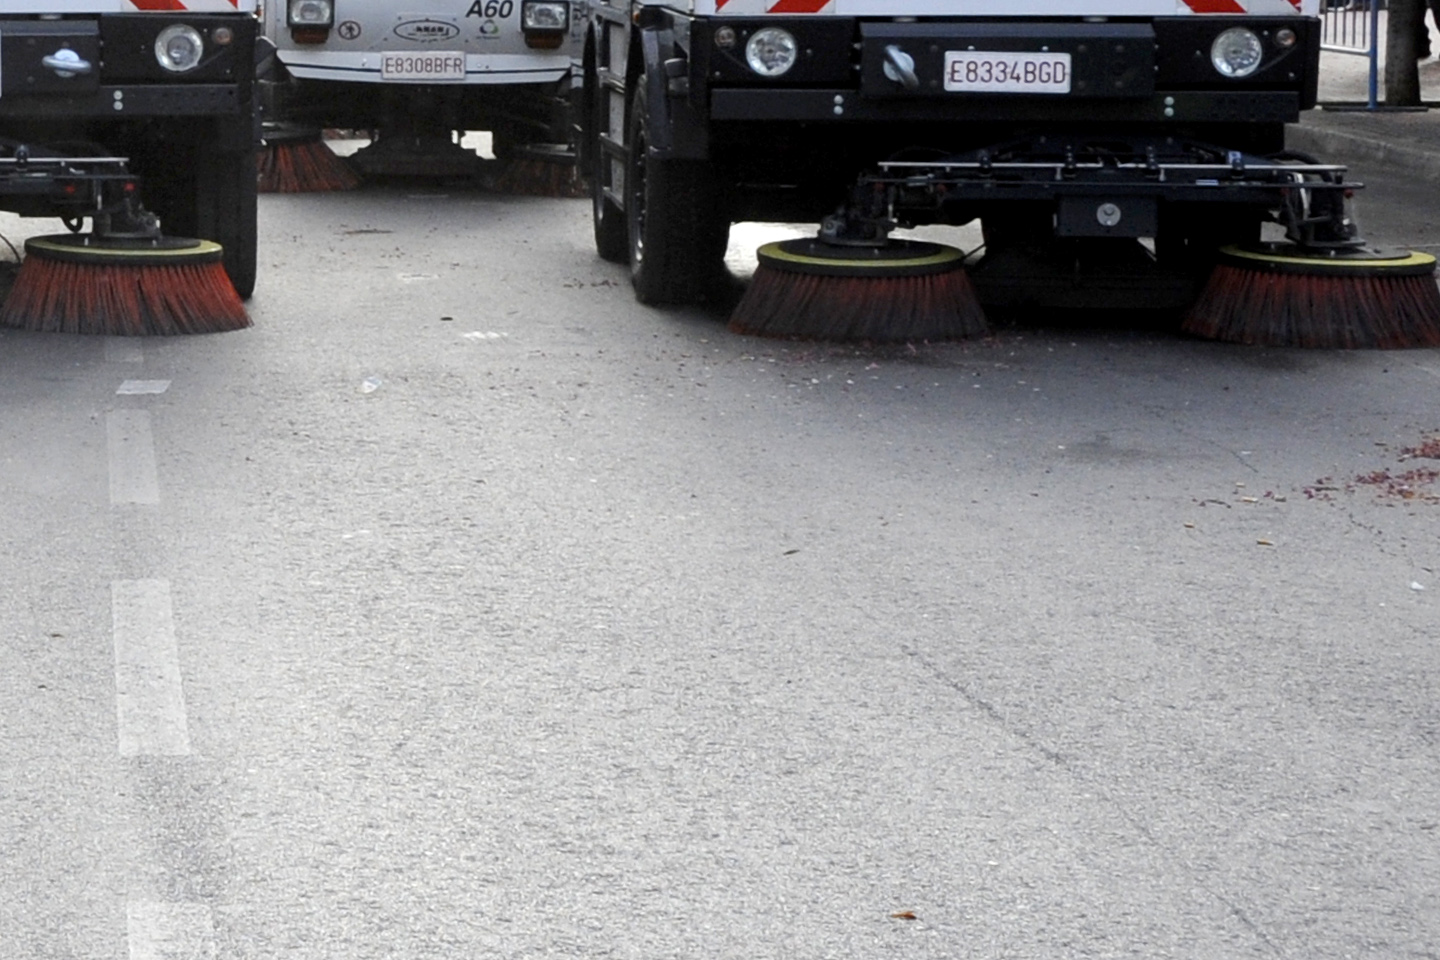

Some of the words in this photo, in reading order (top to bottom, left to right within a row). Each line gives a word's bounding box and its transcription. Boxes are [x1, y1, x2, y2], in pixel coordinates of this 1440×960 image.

[465, 0, 514, 19] A60
[384, 57, 463, 74] E8308BFR
[951, 60, 1066, 83] E8334BGD
